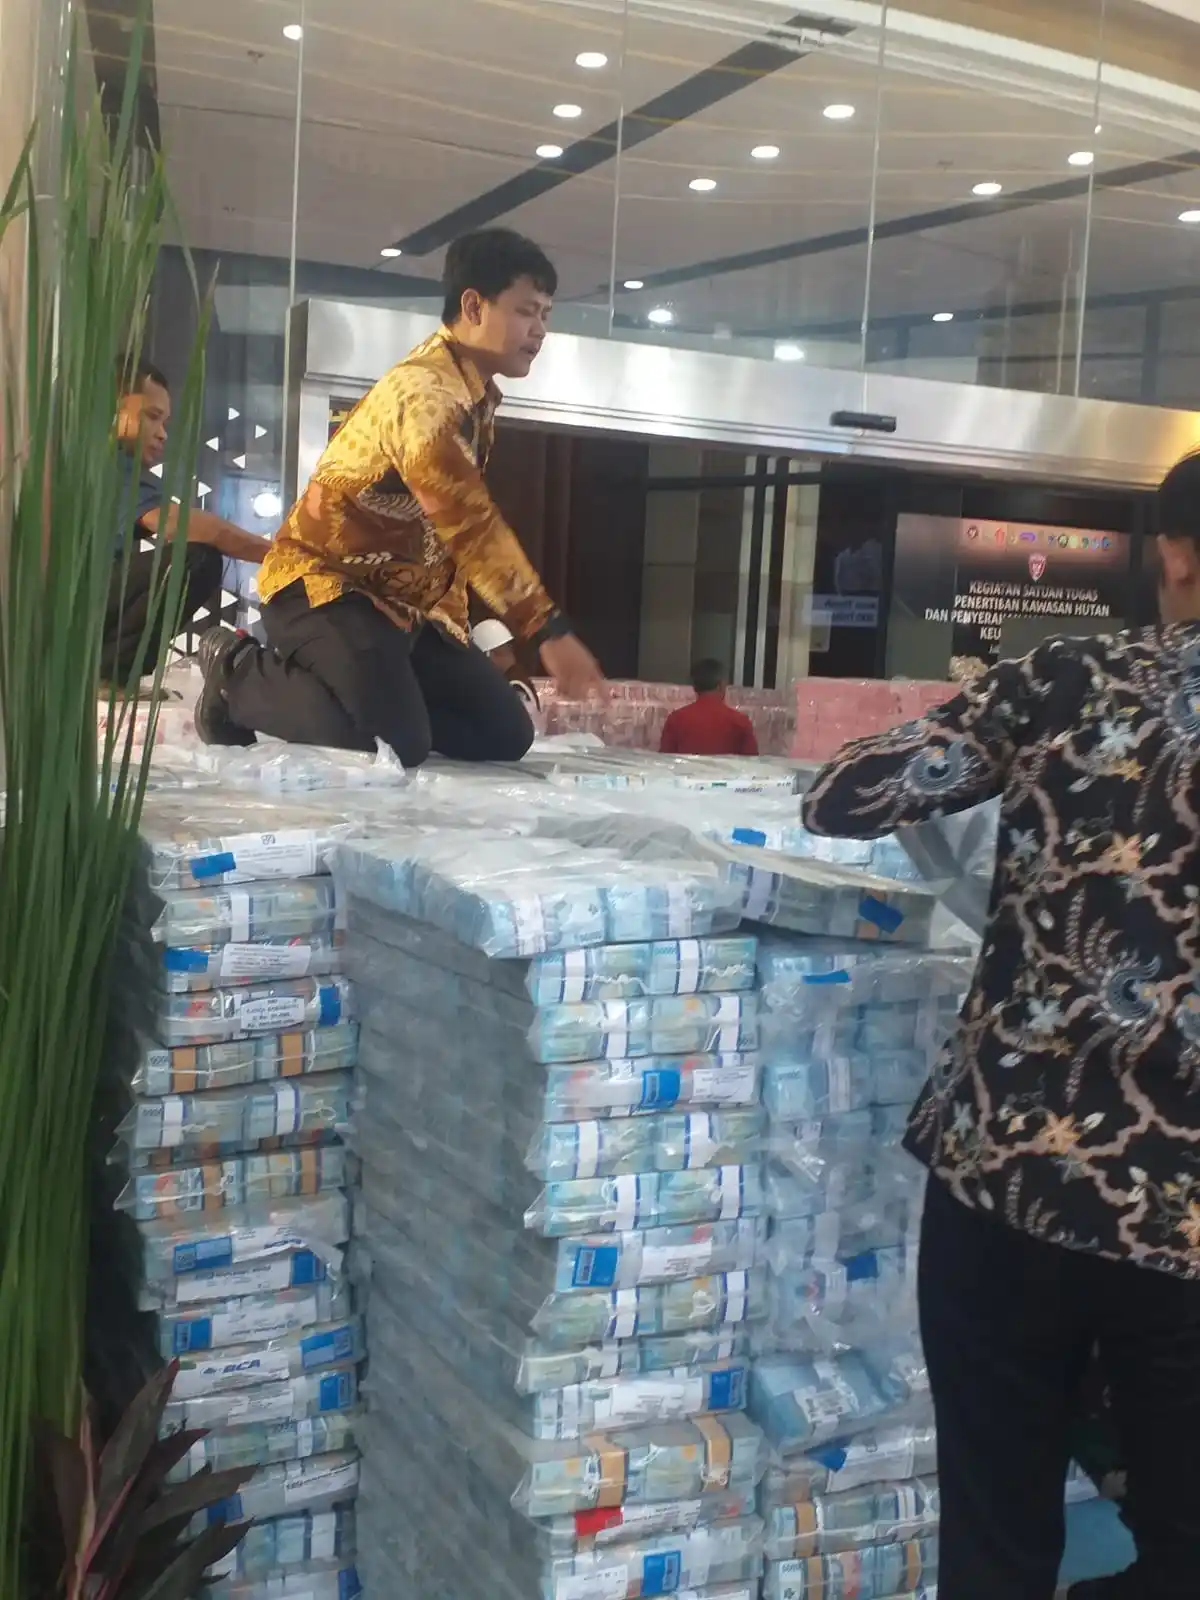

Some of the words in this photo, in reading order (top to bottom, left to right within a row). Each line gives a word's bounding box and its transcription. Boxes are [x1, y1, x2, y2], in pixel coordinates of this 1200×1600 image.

[968, 581, 1021, 597] KEGIATAN
[1022, 584, 1064, 599] SATUAN
[1065, 587, 1099, 602] TUGAS
[954, 595, 1020, 612] PENERTIBAN
[1021, 599, 1073, 615] KAWASAN
[1074, 603, 1110, 617] HUTAN
[924, 608, 949, 622] DAN
[950, 609, 1014, 626] PENYERA
[980, 627, 1001, 641] KEU
